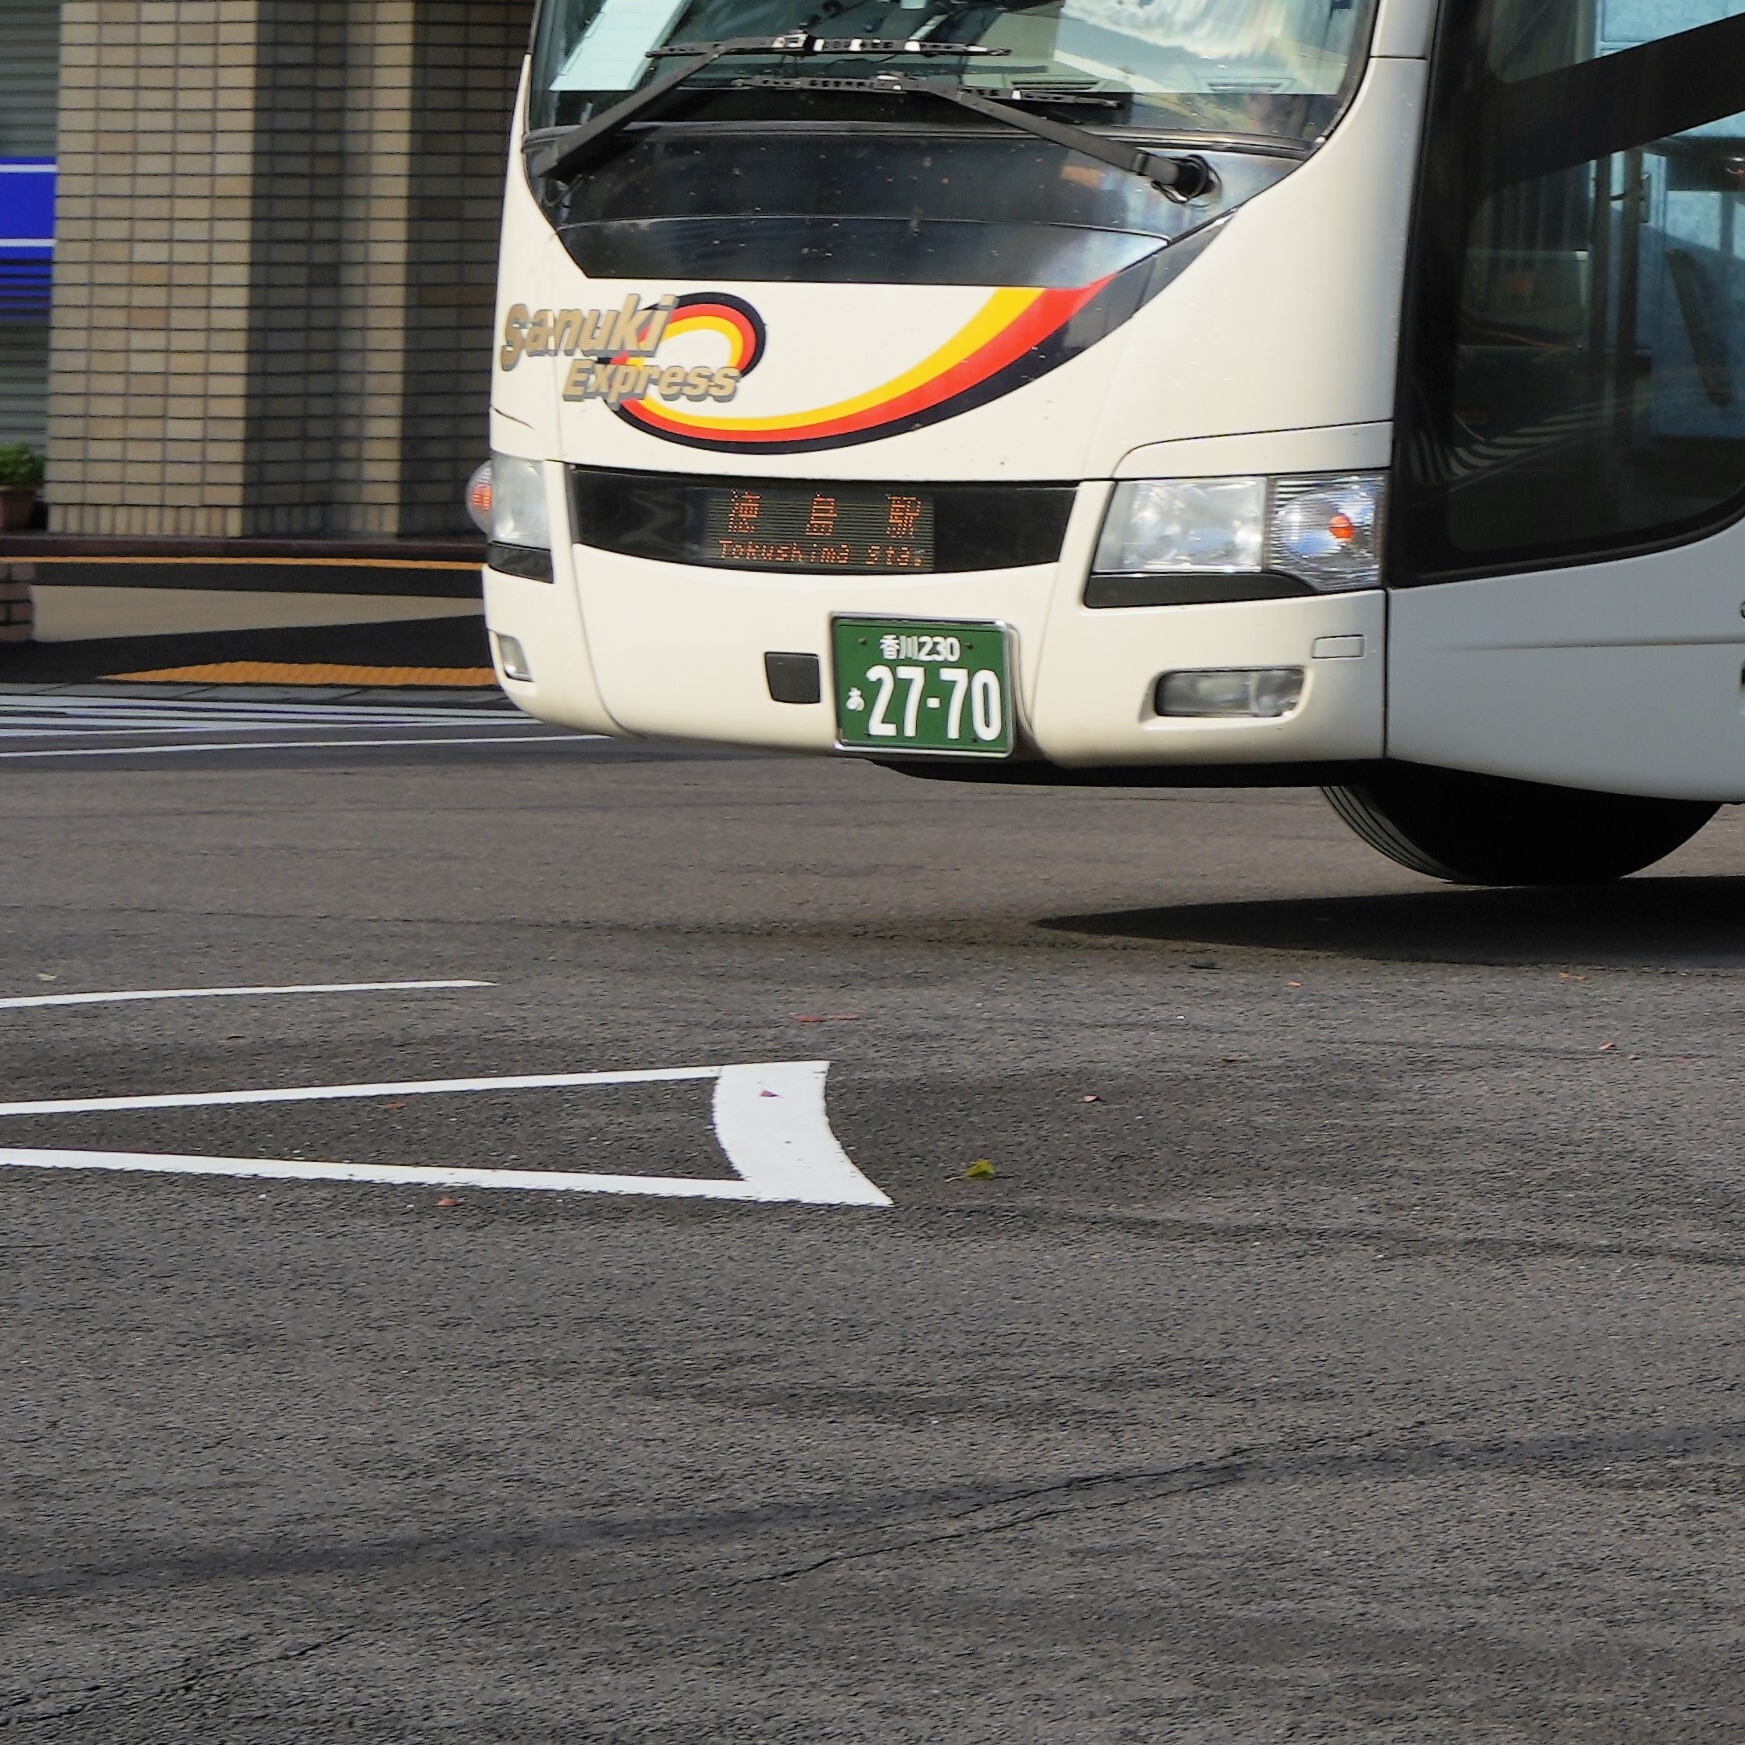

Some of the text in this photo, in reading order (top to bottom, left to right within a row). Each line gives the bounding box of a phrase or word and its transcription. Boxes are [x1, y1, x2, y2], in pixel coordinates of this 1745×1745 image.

[500, 292, 680, 371] Sanuki
[562, 358, 742, 411] Express
[879, 634, 961, 663] 香川230
[865, 664, 1003, 742] 27-70
